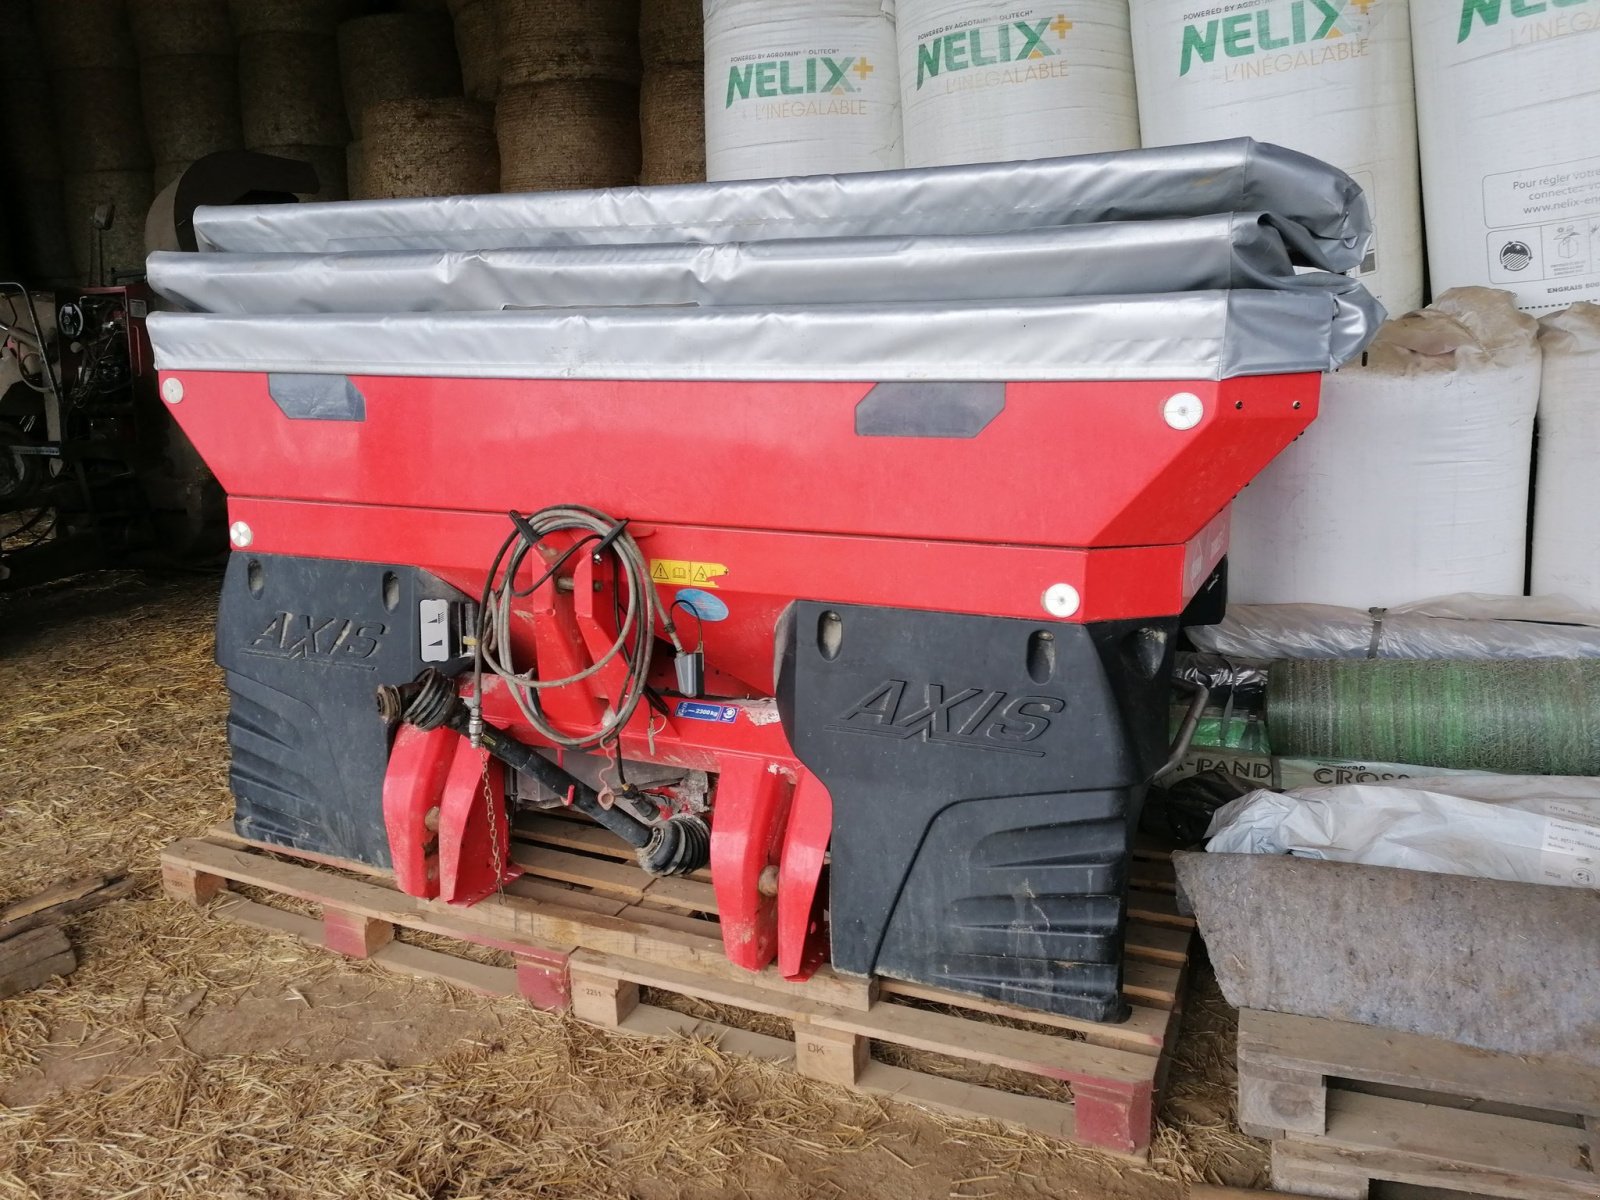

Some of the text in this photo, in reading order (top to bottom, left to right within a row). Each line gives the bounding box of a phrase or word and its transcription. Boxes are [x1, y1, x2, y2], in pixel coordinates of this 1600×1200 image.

[1183, 8, 1222, 21] POWERED
[1224, 5, 1235, 13] BY
[917, 27, 944, 41] POWERED
[944, 24, 953, 32] BY
[730, 53, 757, 63] POWERED
[1513, 180, 1537, 190] Pour
[1539, 174, 1571, 187] régler
[250, 610, 391, 659] AXIS
[839, 678, 1066, 743] AXIS
[807, 1042, 825, 1056] DK
